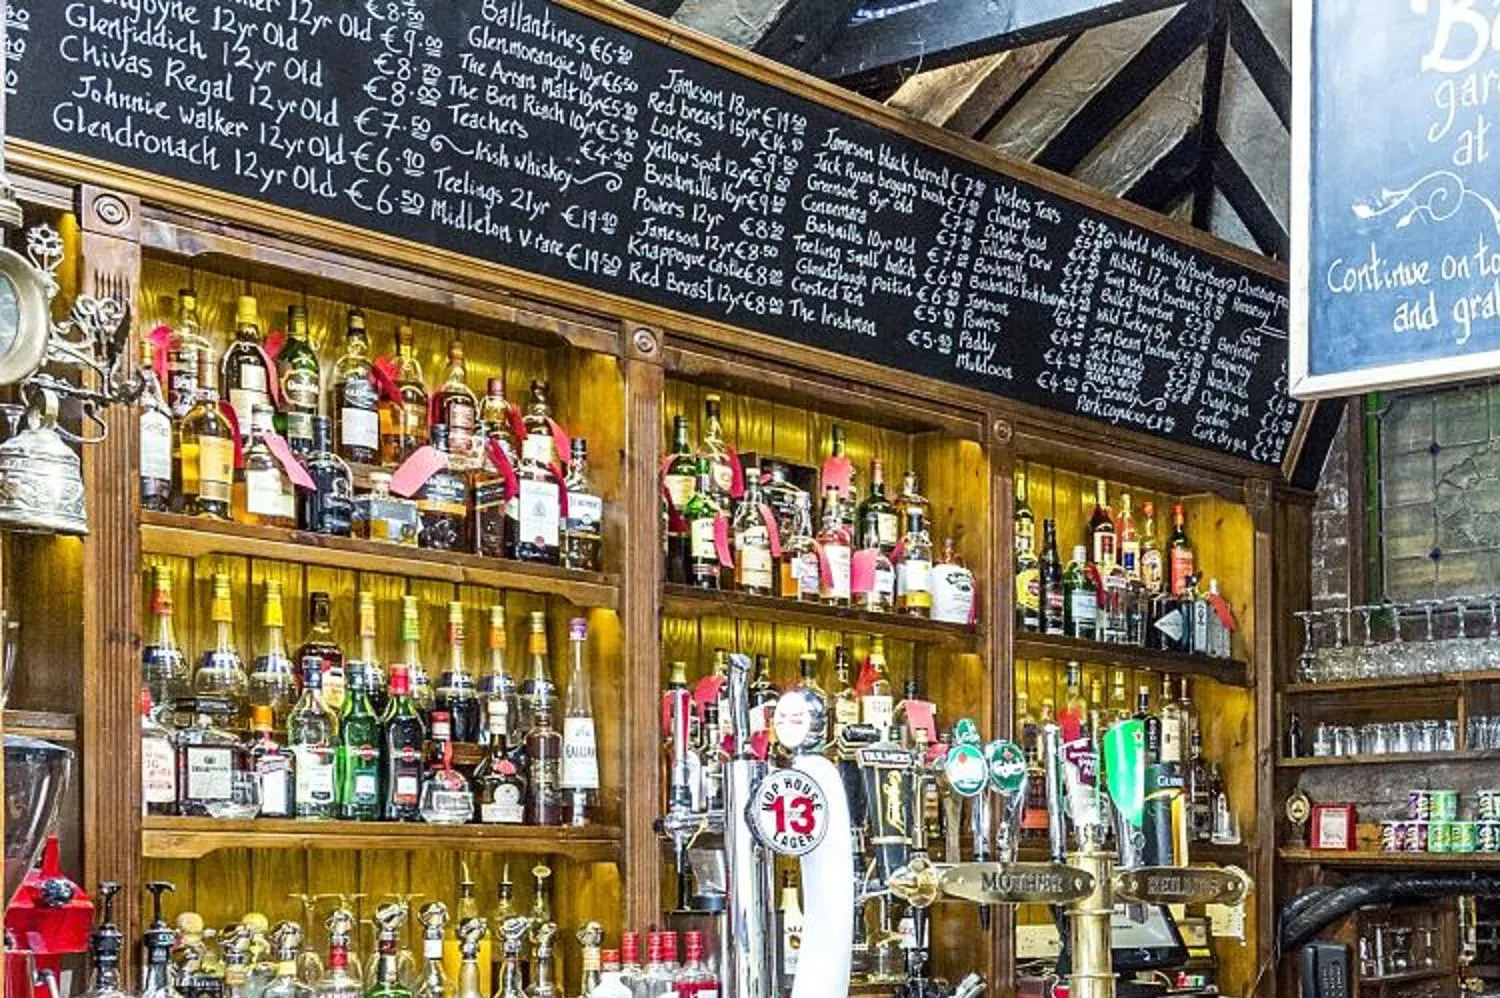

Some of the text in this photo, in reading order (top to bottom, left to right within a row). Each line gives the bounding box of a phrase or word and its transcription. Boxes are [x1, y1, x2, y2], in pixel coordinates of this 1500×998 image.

[65, 3, 207, 60] Glenfiddich
[222, 41, 277, 83] 12yr
[283, 57, 323, 88] Old
[211, 6, 258, 50] 12yr
[263, 22, 299, 50] Old
[338, 13, 372, 41] Old
[481, 0, 585, 54] Ballantines
[459, 53, 487, 77] The
[468, 26, 577, 80] Glenmorangie
[59, 35, 152, 78] Chivas
[164, 57, 234, 105] Regal
[249, 85, 298, 124] 12yr
[300, 97, 340, 126] Old
[448, 75, 479, 100] The
[486, 85, 517, 110] Ben
[660, 69, 724, 108] Jameson
[72, 76, 171, 119] Johnnie
[260, 122, 304, 158] 12yr
[307, 133, 346, 164] Old
[448, 103, 529, 139] Teachers
[648, 92, 676, 116] Red
[53, 102, 220, 170] Glendronach
[235, 148, 287, 193] 12yr
[293, 165, 337, 198] Old
[650, 116, 702, 147] Lockes
[1453, 114, 1492, 166] at
[434, 166, 503, 209] Teelings
[632, 187, 685, 218] Powers
[636, 217, 700, 248] Jameson
[628, 261, 660, 288] Red
[1327, 241, 1430, 294] Continue
[788, 298, 817, 323] The
[1393, 294, 1439, 333] and
[770, 795, 817, 834] 13
